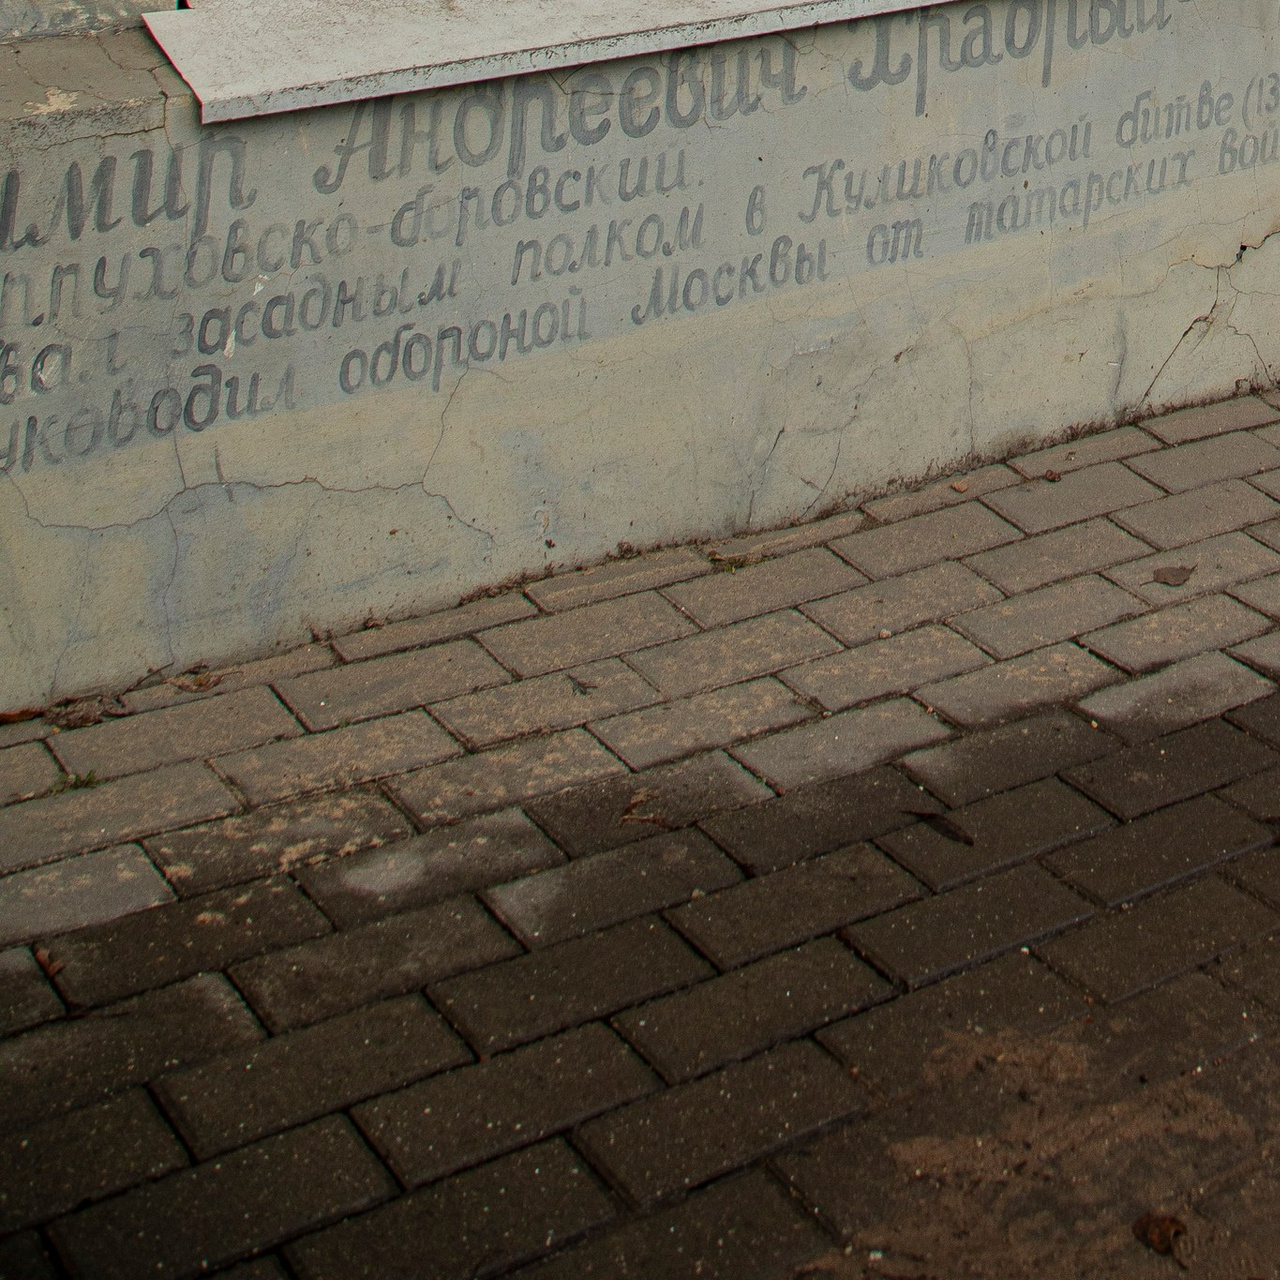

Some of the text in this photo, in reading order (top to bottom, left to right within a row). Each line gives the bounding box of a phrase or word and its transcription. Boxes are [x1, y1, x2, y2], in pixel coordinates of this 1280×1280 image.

[172, 259, 462, 360] засадным
[511, 202, 705, 286] полком
[745, 183, 768, 237] в
[798, 113, 1093, 225] Куликовской
[1115, 79, 1234, 149] битве
[313, 34, 808, 195] Андреевич
[339, 286, 593, 392] обороной
[866, 218, 924, 266] от
[964, 149, 1196, 244] татарских
